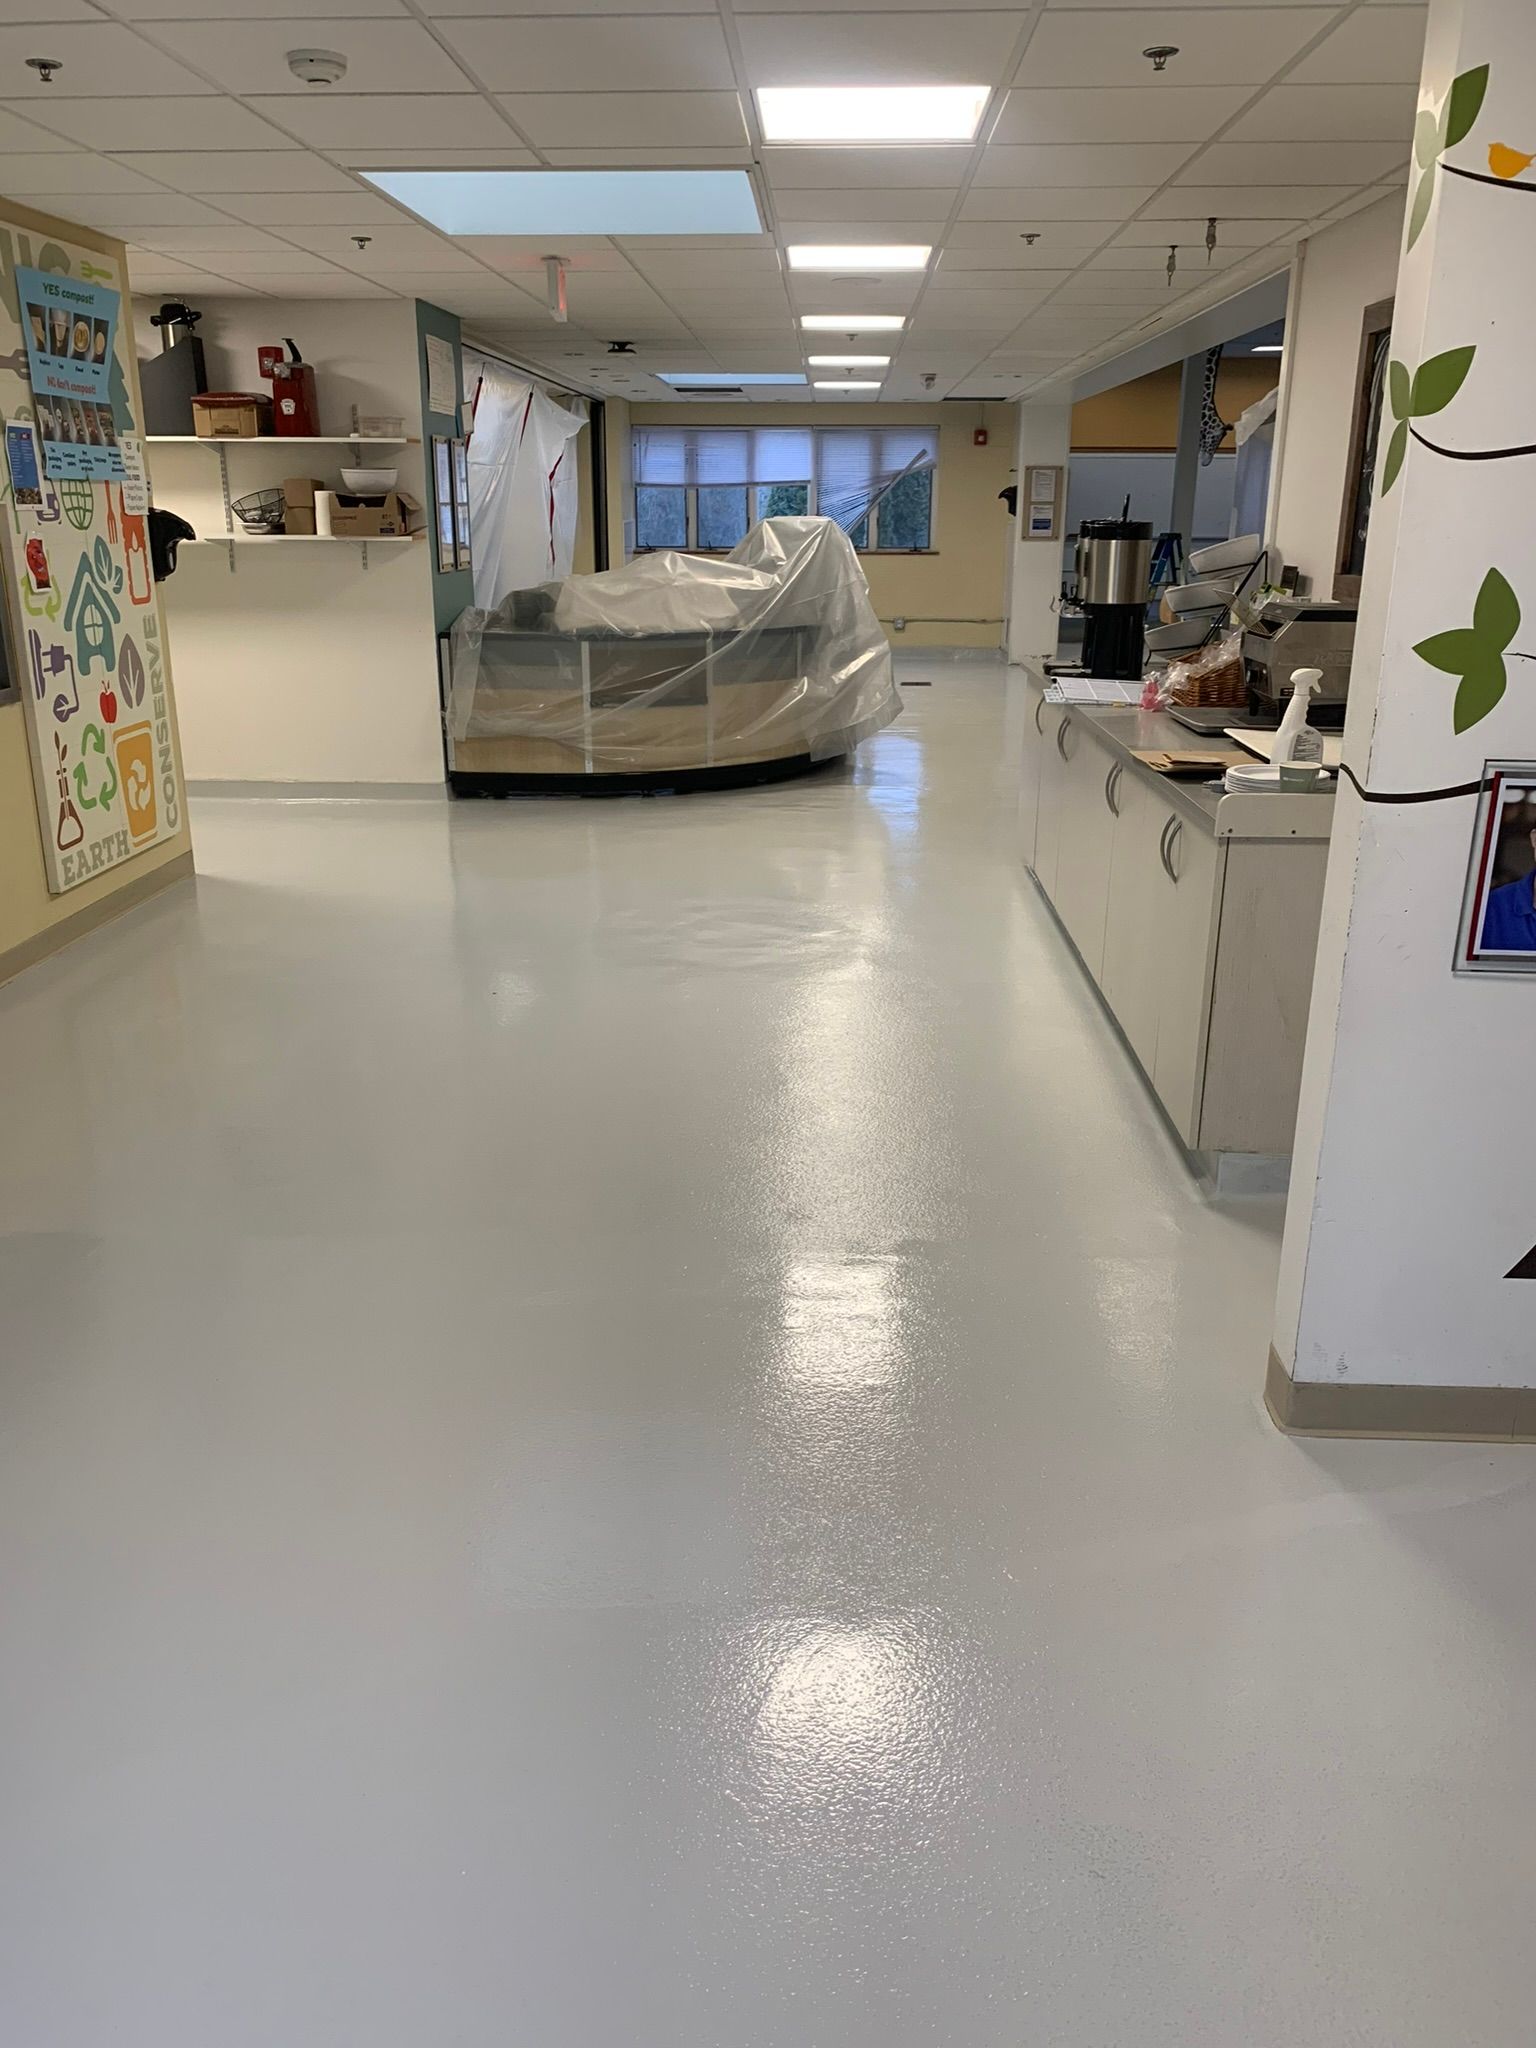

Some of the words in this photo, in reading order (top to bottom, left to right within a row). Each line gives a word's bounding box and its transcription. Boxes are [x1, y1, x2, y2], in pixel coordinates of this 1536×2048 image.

[43, 283, 60, 297] YES
[61, 290, 94, 304] compost!
[142, 612, 178, 829] CONSERVE
[61, 829, 130, 886] EARTH
